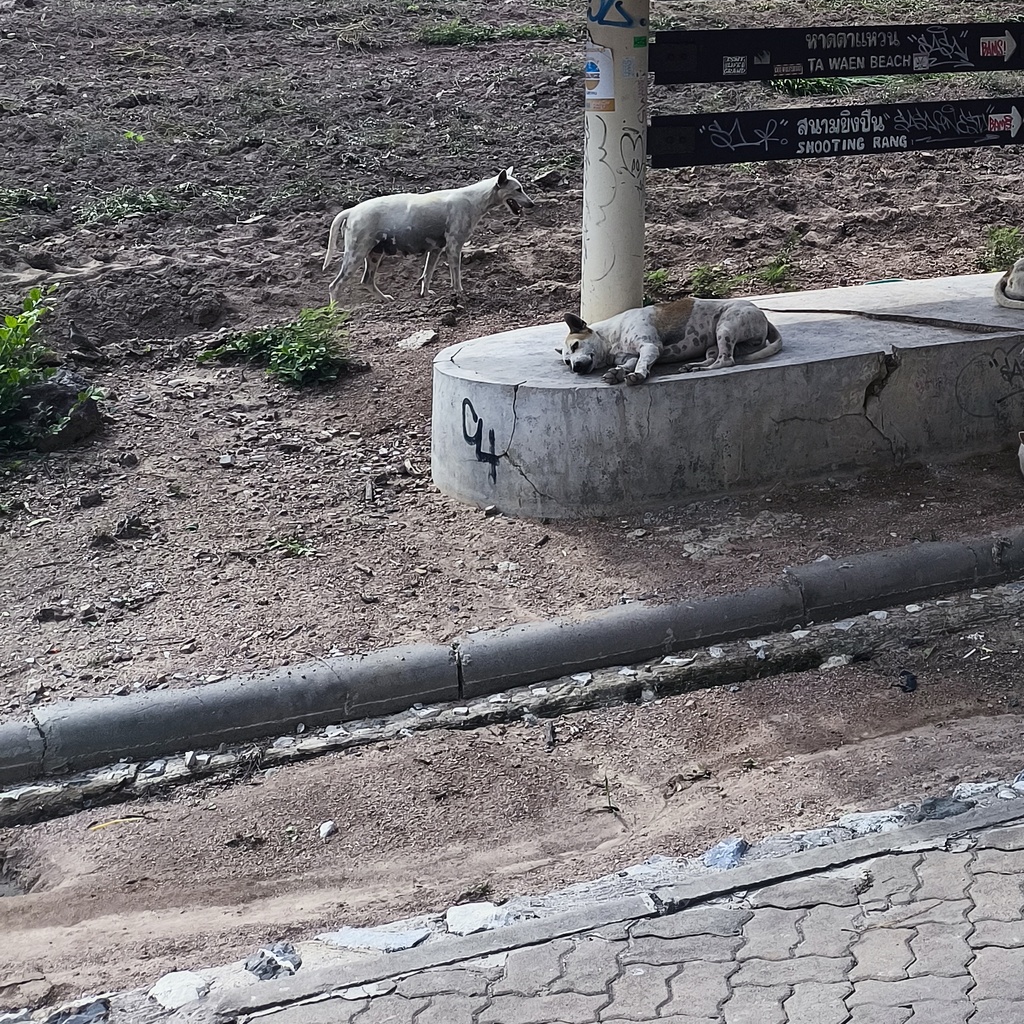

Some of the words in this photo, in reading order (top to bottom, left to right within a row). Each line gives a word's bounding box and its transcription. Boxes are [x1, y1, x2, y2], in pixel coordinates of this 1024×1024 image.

[807, 58, 825, 73] TA
[829, 56, 865, 70] WAEN
[870, 54, 911, 68] BEACH
[797, 109, 885, 136] สนามยิงปืน
[796, 138, 865, 154] SHOOTING
[873, 136, 907, 149] RANG
